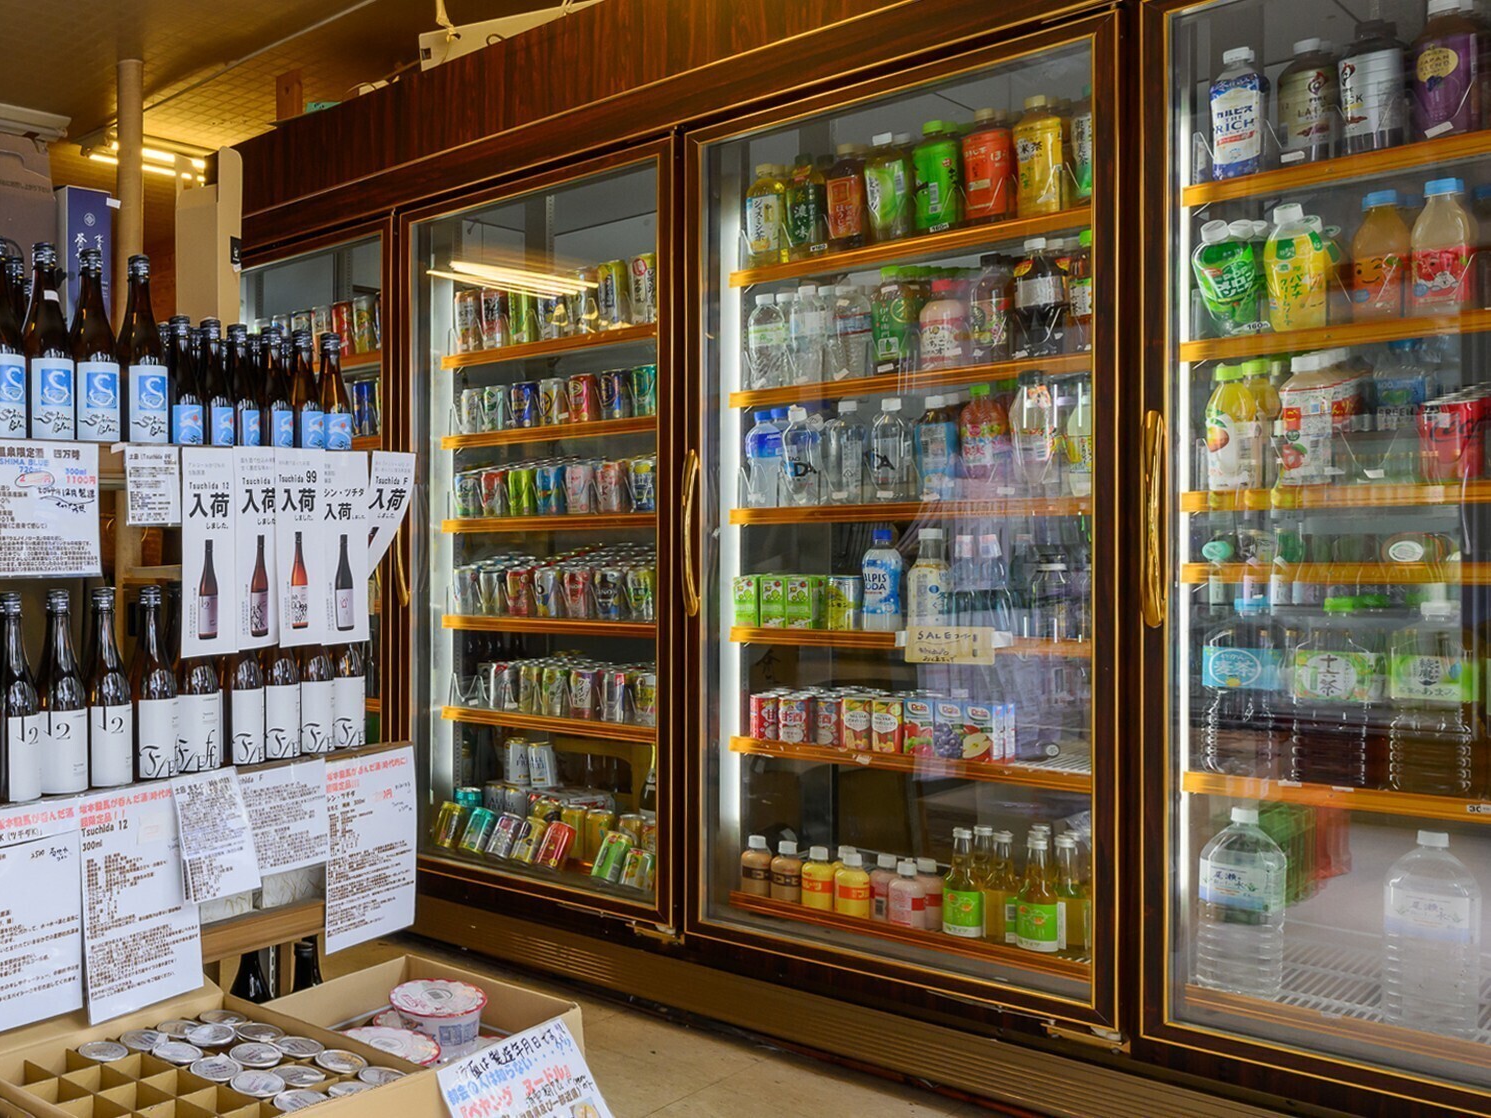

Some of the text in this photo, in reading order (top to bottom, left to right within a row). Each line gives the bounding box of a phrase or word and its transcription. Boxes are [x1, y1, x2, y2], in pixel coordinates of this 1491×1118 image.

[1216, 118, 1255, 134] RICH
[1225, 115, 1242, 123] THE
[1290, 272, 1303, 298] バナナ
[66, 475, 97, 485] 1100円
[242, 477, 270, 485] Tsuchida
[278, 470, 317, 484] Tsuchida 99
[375, 476, 409, 485] Tsuchida F
[189, 481, 219, 490] Tsuchida
[281, 488, 316, 512] 入荷
[324, 488, 365, 498] シン・ツチダ
[368, 488, 407, 511] 入荷
[189, 493, 230, 518] 入荷
[241, 488, 275, 514] 入荷
[324, 503, 352, 521] 入荷
[205, 522, 229, 530] しました。
[1215, 660, 1255, 678] 麦茶
[1318, 653, 1340, 695] 十六茶
[910, 703, 928, 712] Dole
[971, 708, 989, 718] Dole
[81, 819, 128, 837] Tsuchida 12
[82, 839, 103, 852] 300ml
